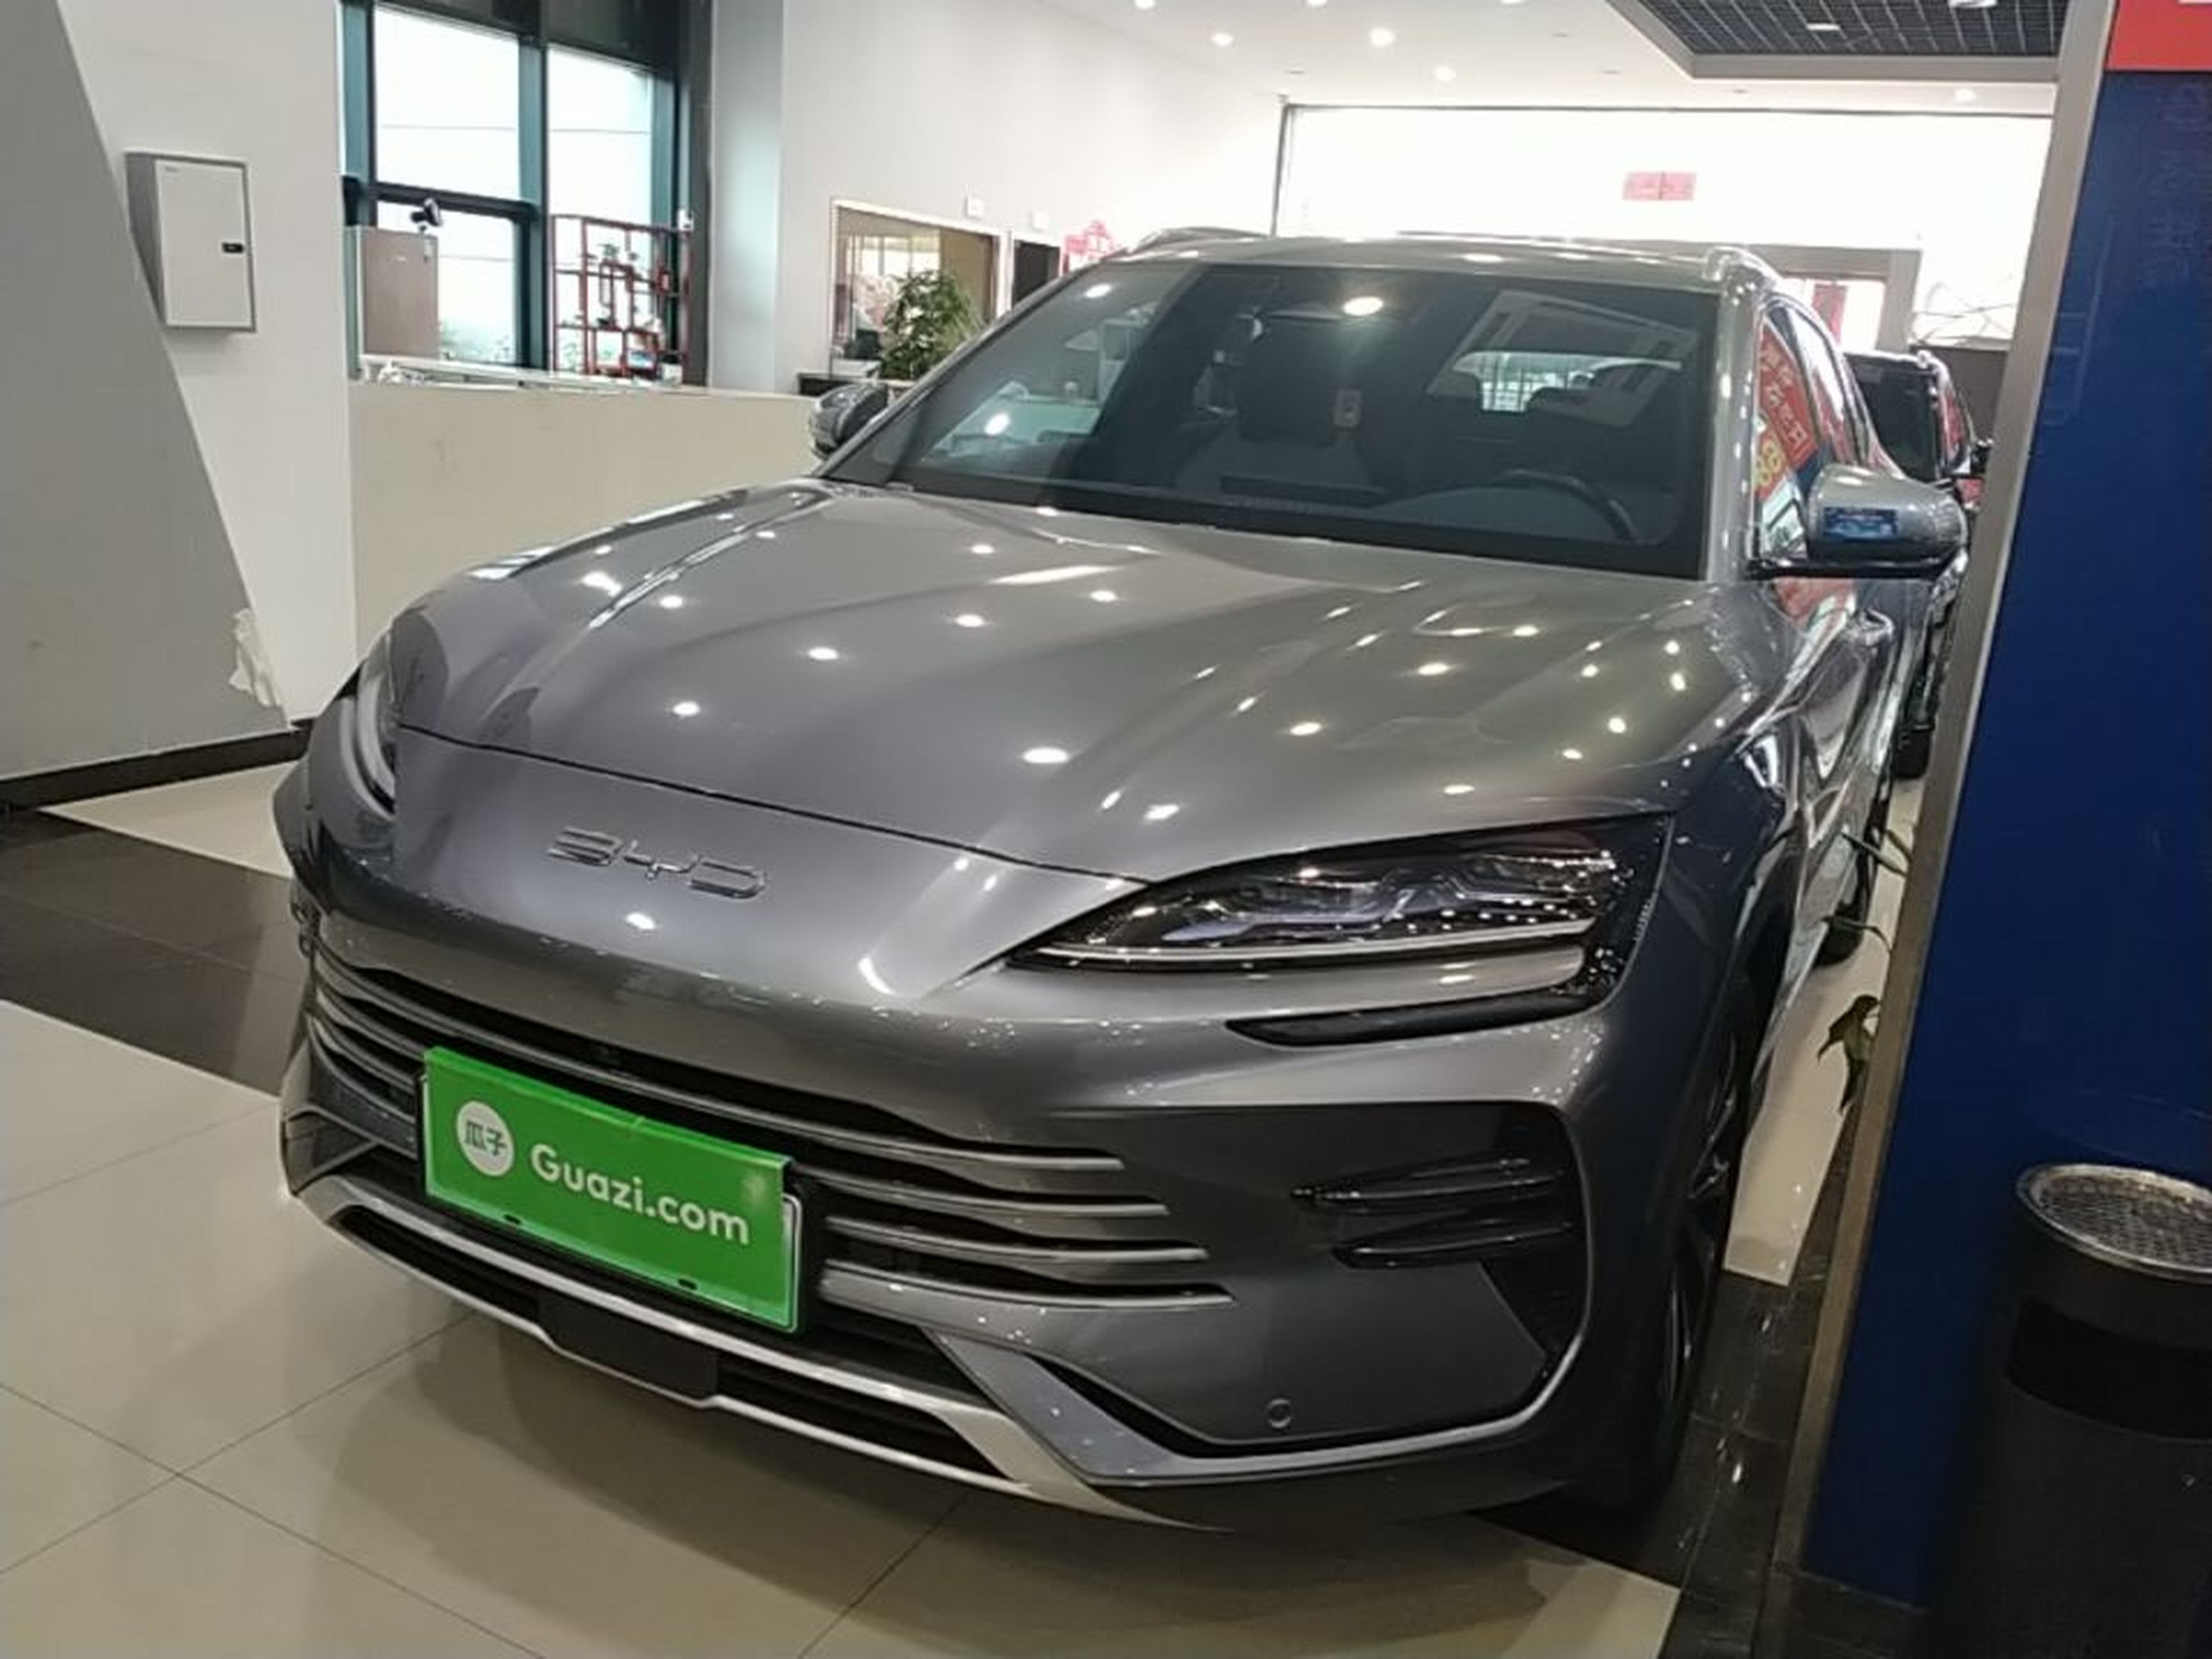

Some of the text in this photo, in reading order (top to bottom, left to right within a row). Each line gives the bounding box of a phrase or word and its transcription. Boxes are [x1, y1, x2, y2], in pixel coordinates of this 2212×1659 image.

[547, 825, 766, 899] BYD
[465, 1119, 507, 1157] 瓜子
[531, 1143, 749, 1245] Guazi.com
